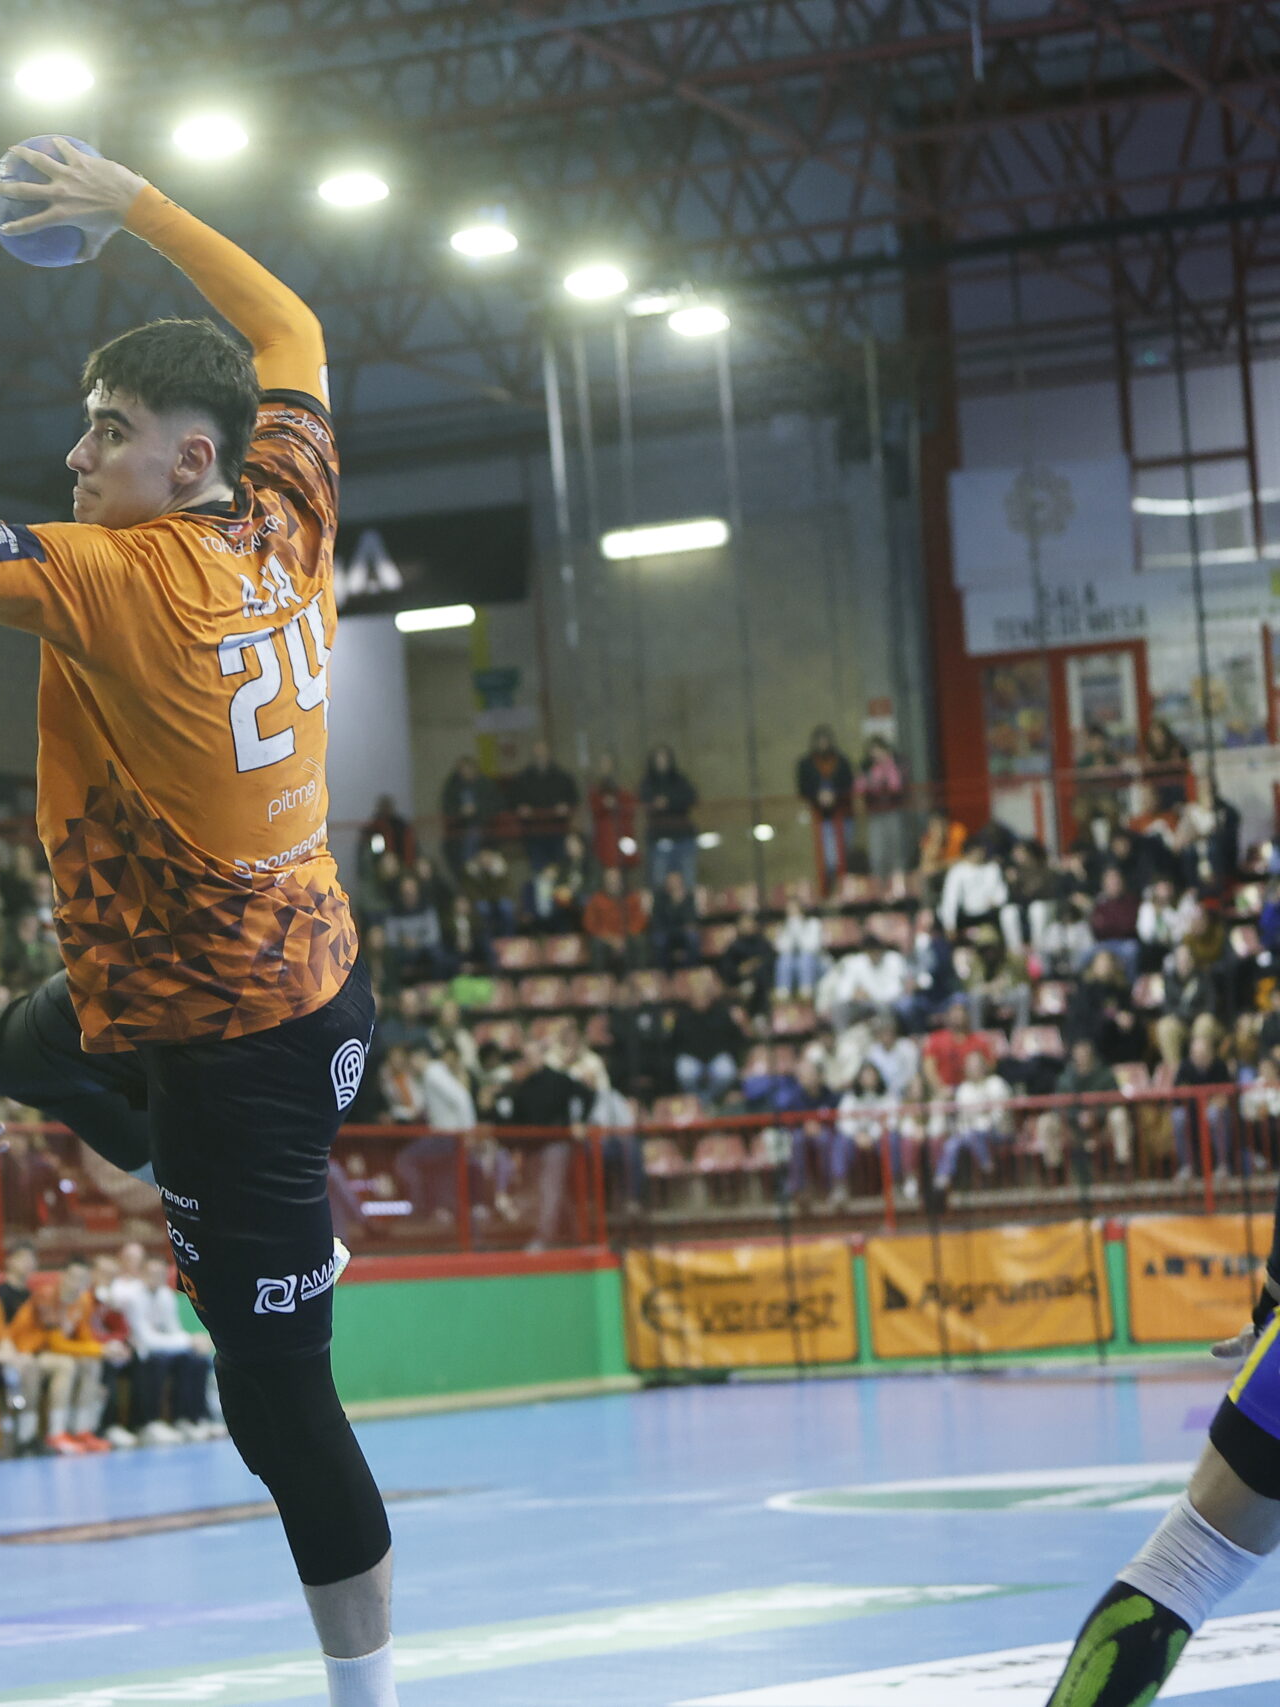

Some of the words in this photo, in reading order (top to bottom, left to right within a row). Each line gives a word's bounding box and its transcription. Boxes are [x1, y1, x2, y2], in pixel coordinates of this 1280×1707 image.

[239, 553, 302, 618] AJA
[217, 588, 331, 774] 24
[268, 779, 316, 822] pitma
